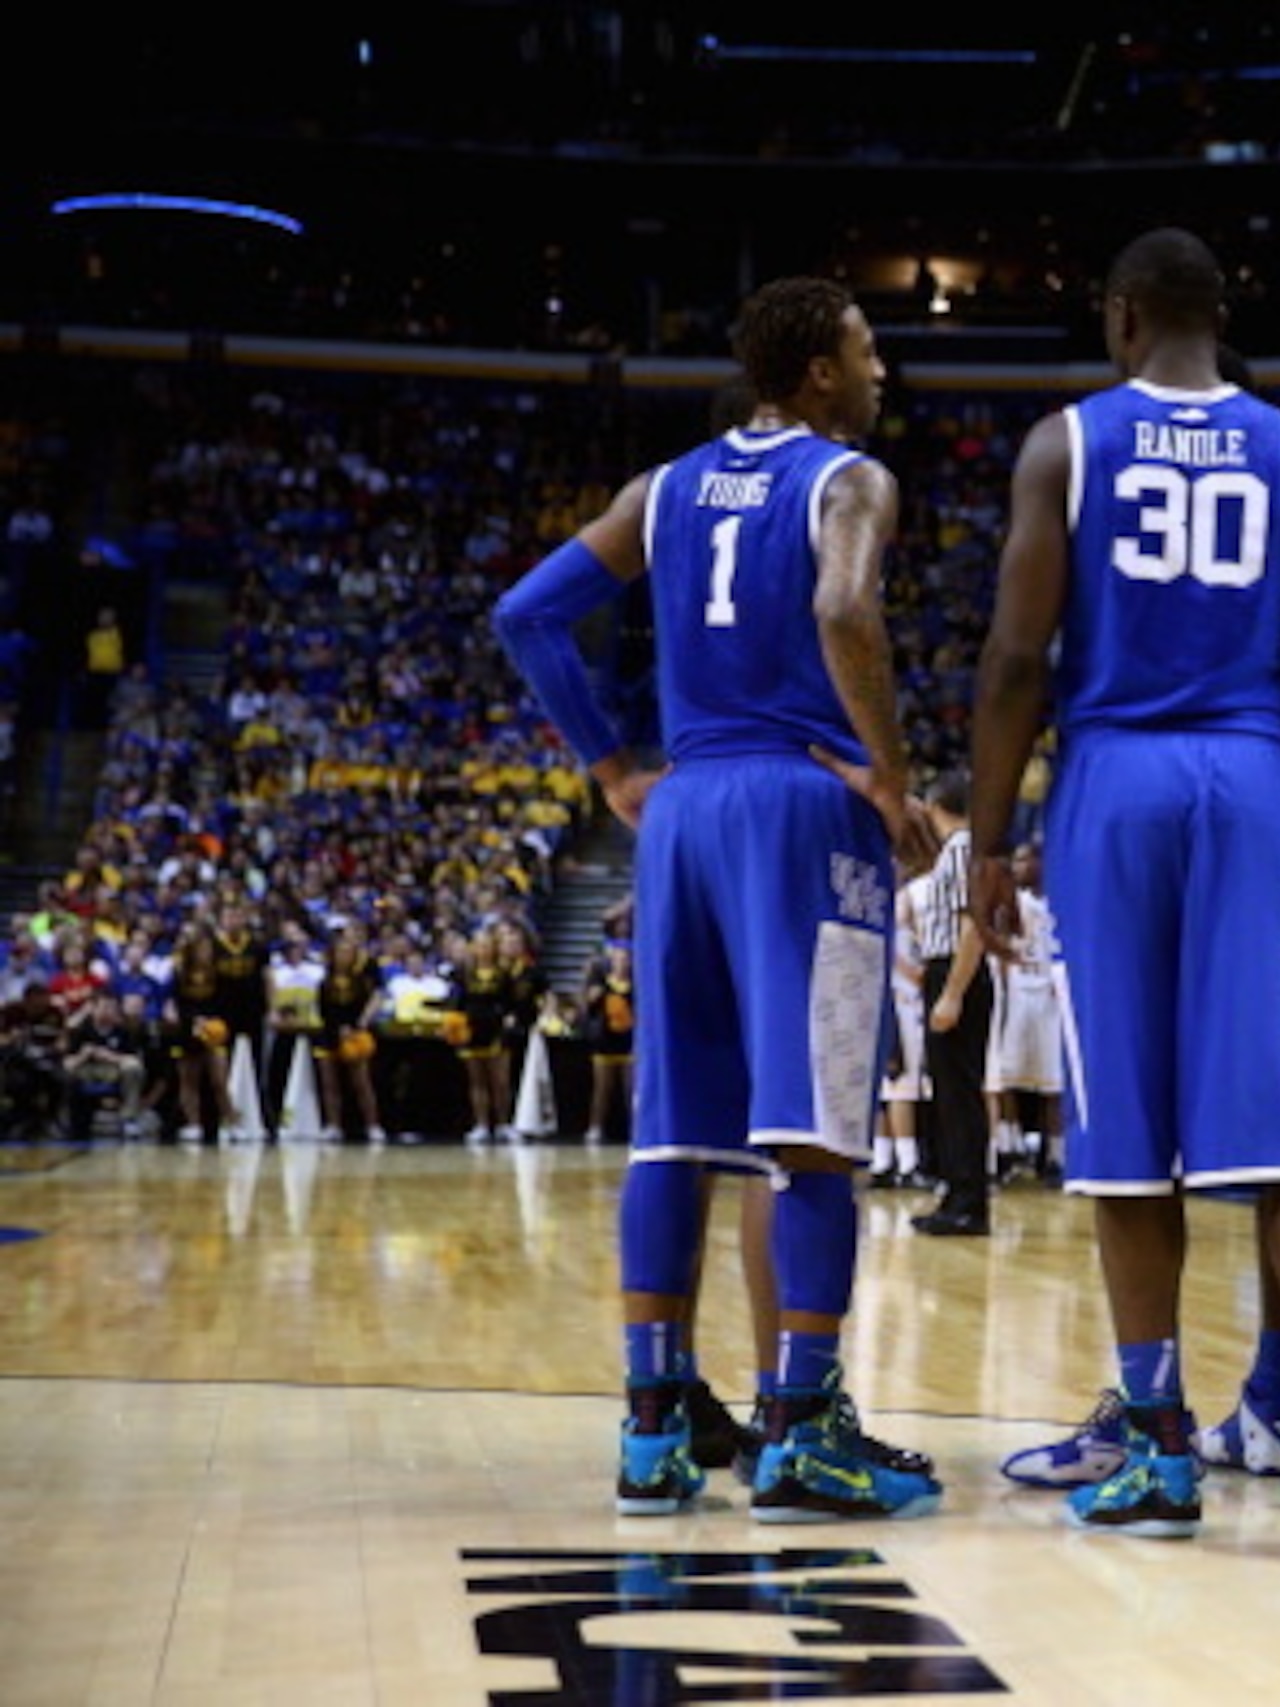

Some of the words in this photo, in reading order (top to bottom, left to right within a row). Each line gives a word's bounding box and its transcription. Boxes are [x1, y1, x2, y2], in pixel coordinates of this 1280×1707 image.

[1134, 420, 1249, 466] RANDLE
[704, 514, 742, 627] 1
[1111, 464, 1270, 588] 30
